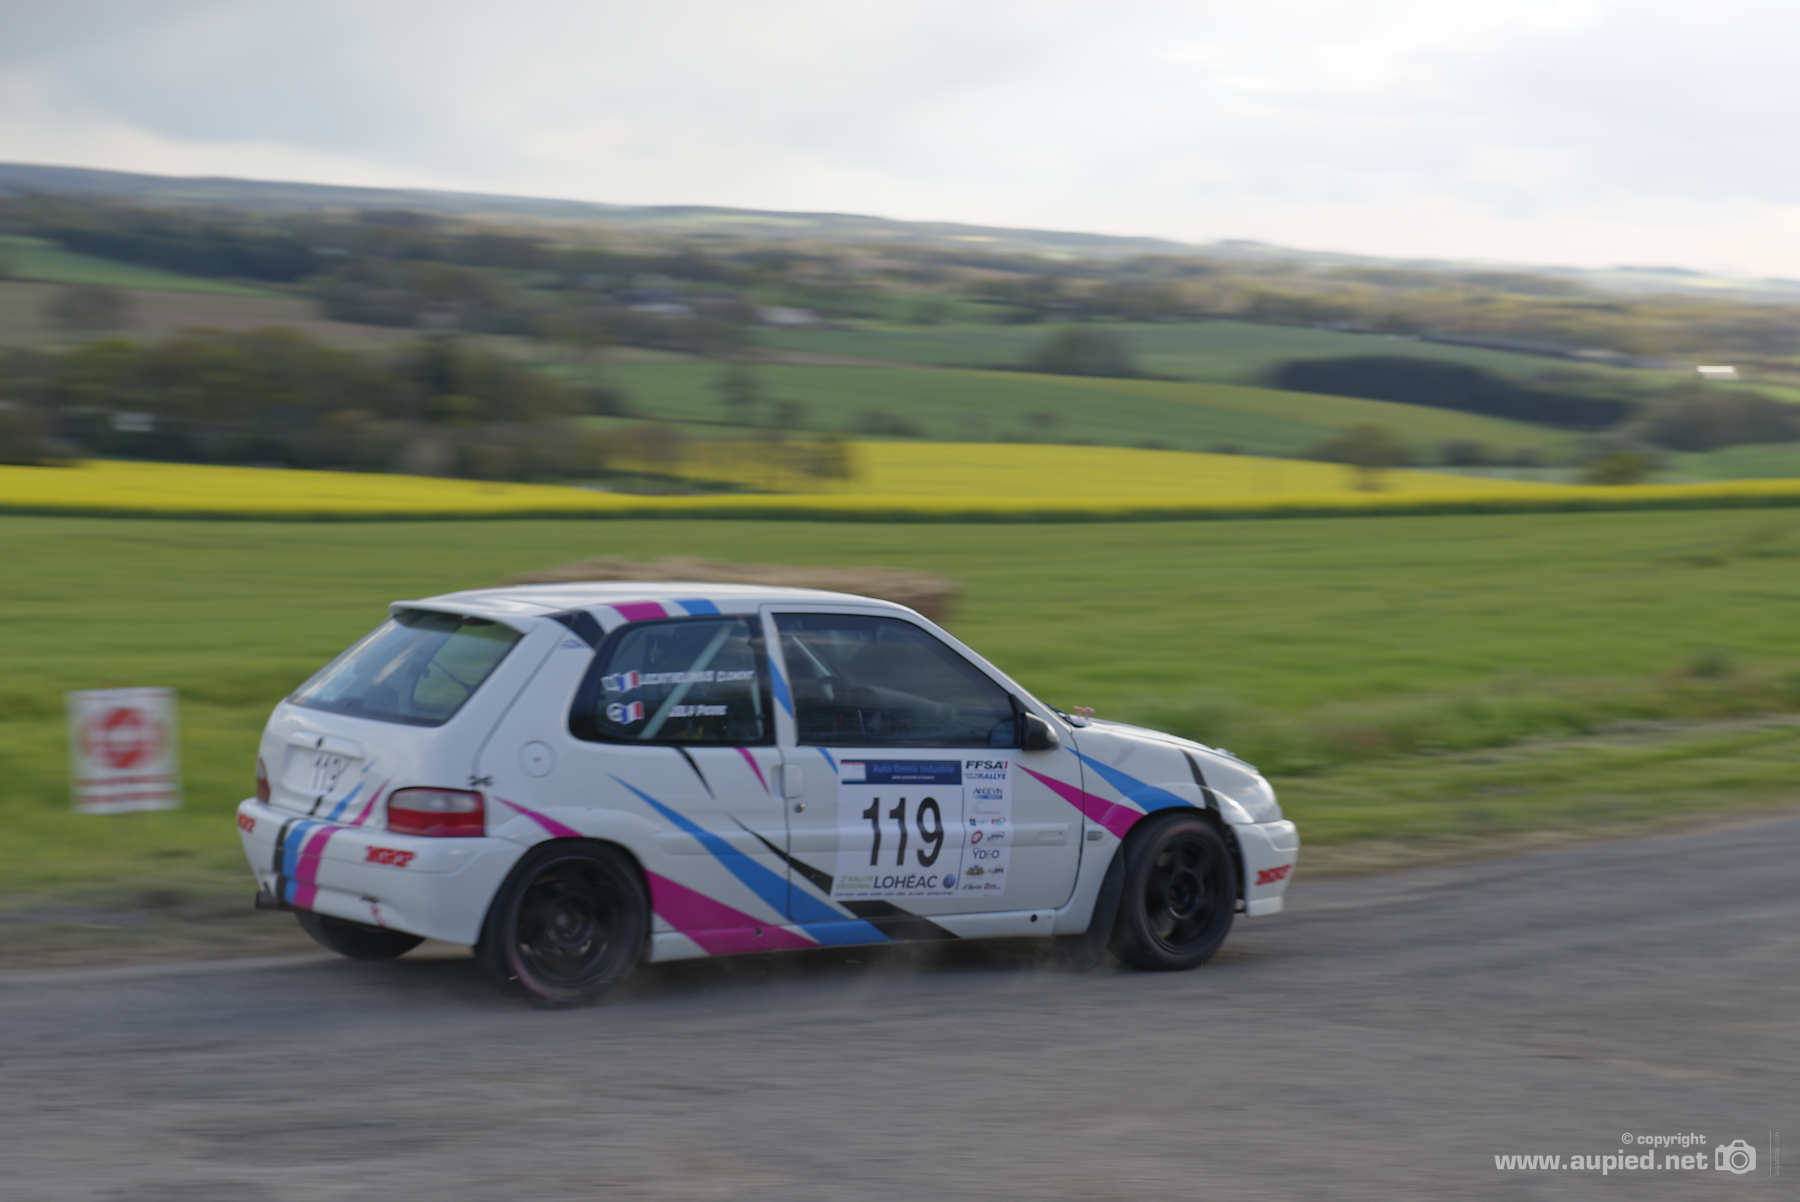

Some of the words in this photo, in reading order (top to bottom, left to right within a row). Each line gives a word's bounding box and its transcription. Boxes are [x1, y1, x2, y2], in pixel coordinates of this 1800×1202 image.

[966, 761, 1003, 769] FFSA
[863, 797, 944, 867] 119
[874, 874, 938, 889] LOHÉAC
